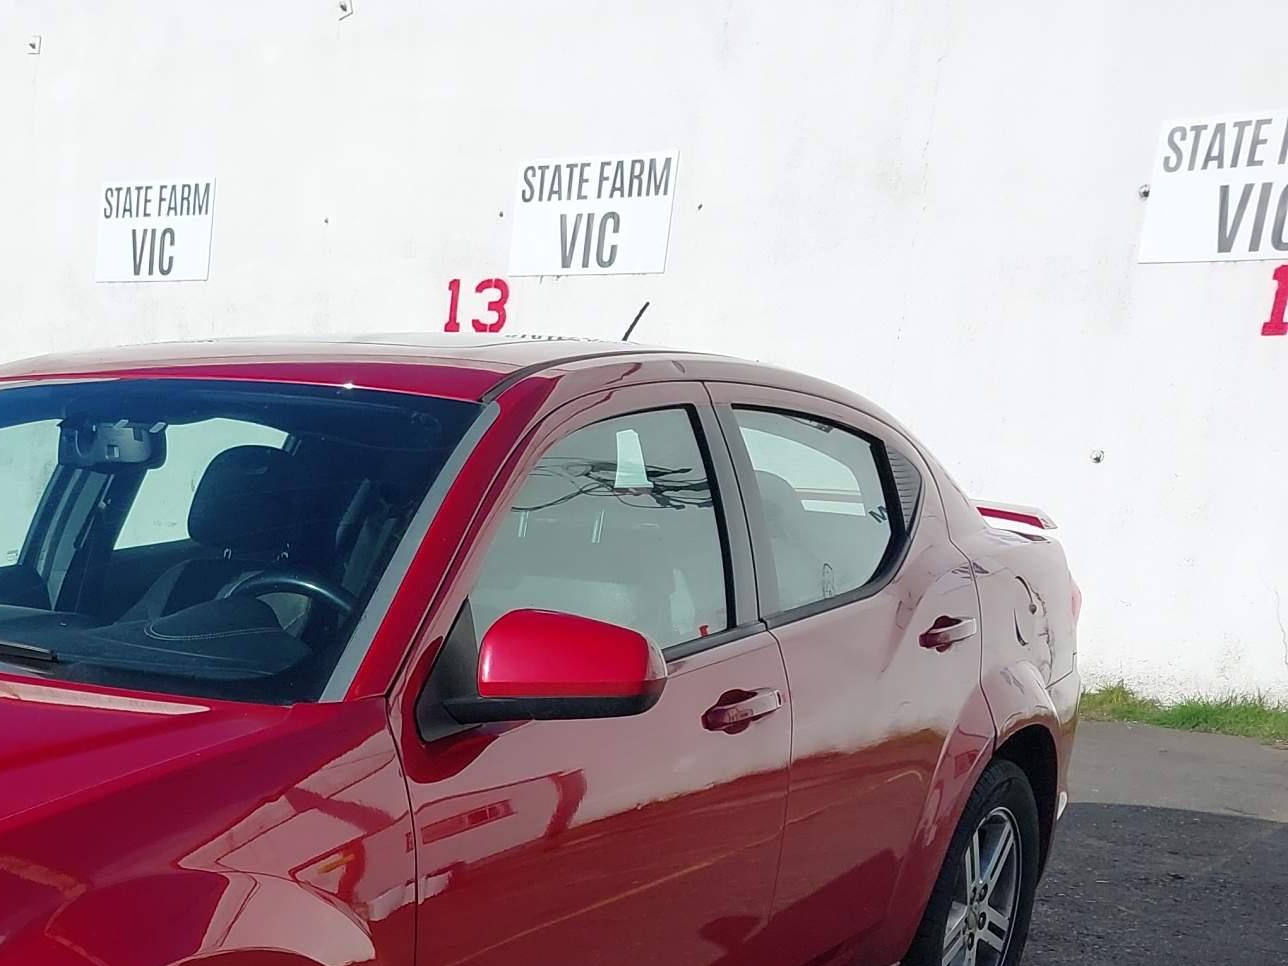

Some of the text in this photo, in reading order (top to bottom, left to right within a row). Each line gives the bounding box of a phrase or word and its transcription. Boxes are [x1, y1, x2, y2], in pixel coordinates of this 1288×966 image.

[1164, 118, 1273, 173] STATE
[103, 182, 211, 220] STATE FARM
[521, 157, 672, 203] STATE FARM
[131, 227, 175, 276] VIC
[559, 211, 621, 269] VIC
[442, 277, 511, 333] 13
